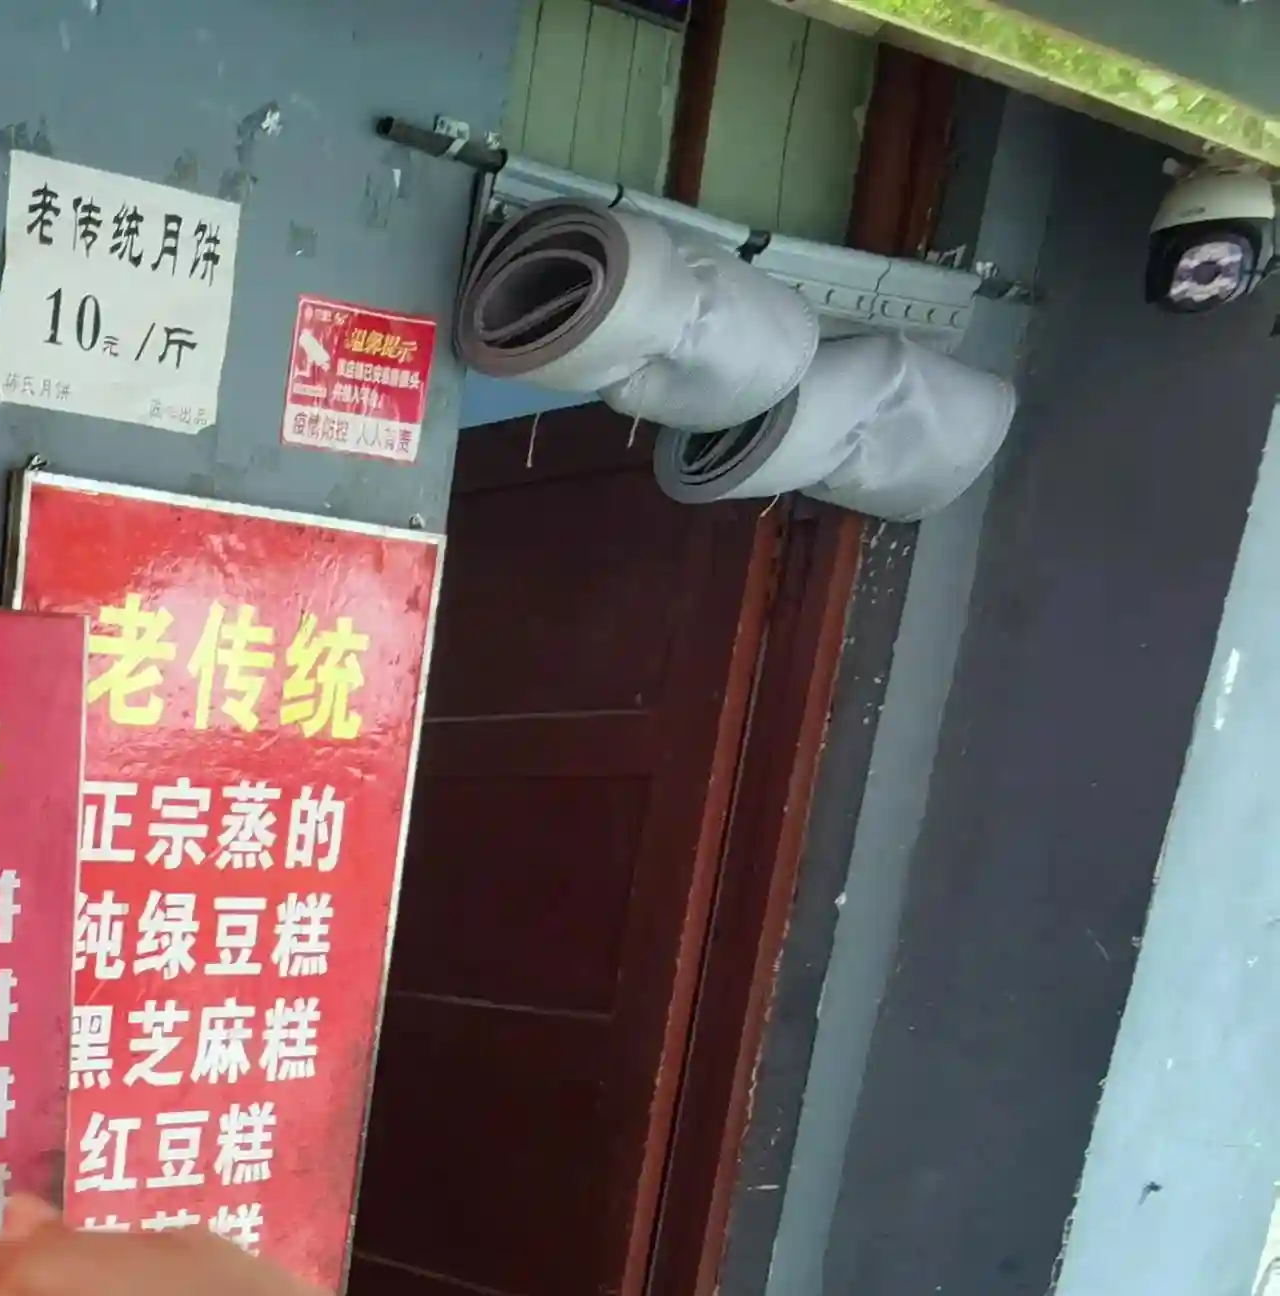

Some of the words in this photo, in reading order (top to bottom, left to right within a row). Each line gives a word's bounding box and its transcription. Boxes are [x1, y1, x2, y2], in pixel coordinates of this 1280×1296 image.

[27, 182, 221, 287] 老传统月饼
[88, 594, 372, 740] 老传统
[78, 778, 346, 874] 正宗蒸的
[73, 890, 335, 981] 纯绿豆糕
[68, 995, 322, 1090] 黑芝麻糕
[75, 1100, 278, 1193] 红豆糕
